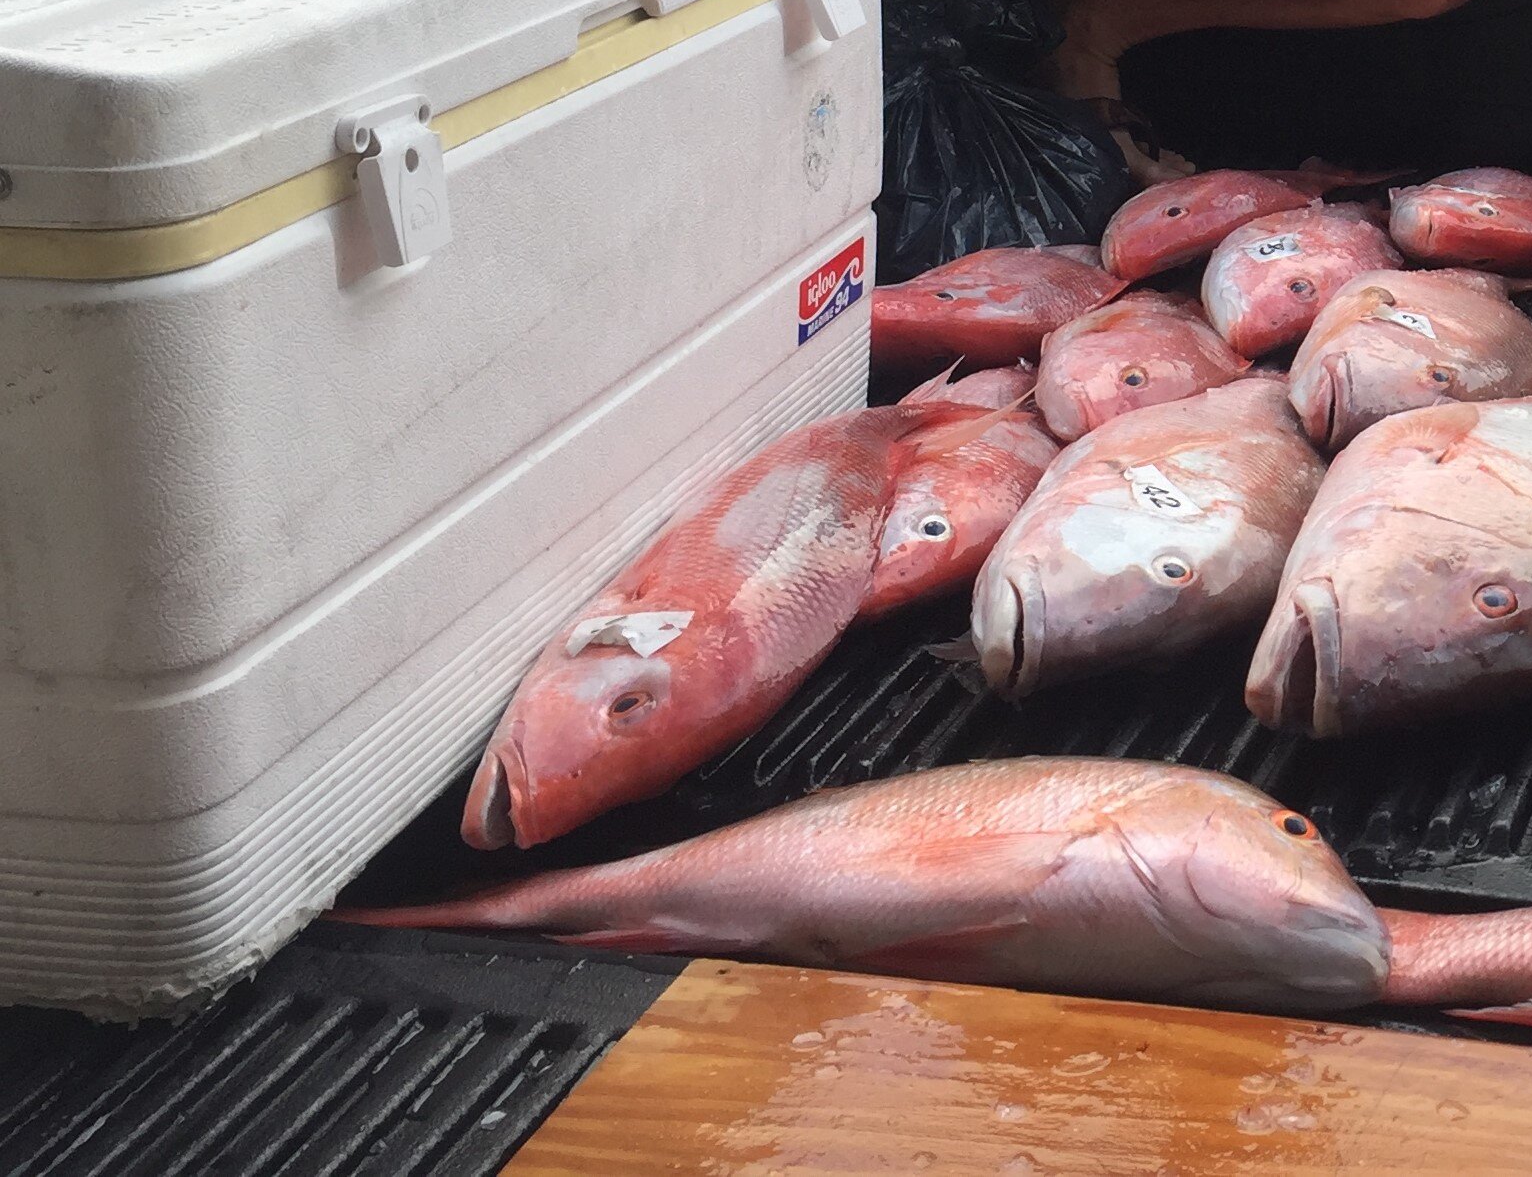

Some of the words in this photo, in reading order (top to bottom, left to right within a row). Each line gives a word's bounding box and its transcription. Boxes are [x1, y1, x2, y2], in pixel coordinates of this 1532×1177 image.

[807, 270, 837, 309] igloo
[807, 306, 836, 337] MARINE
[834, 285, 850, 314] 94
[1142, 485, 1183, 509] 42
